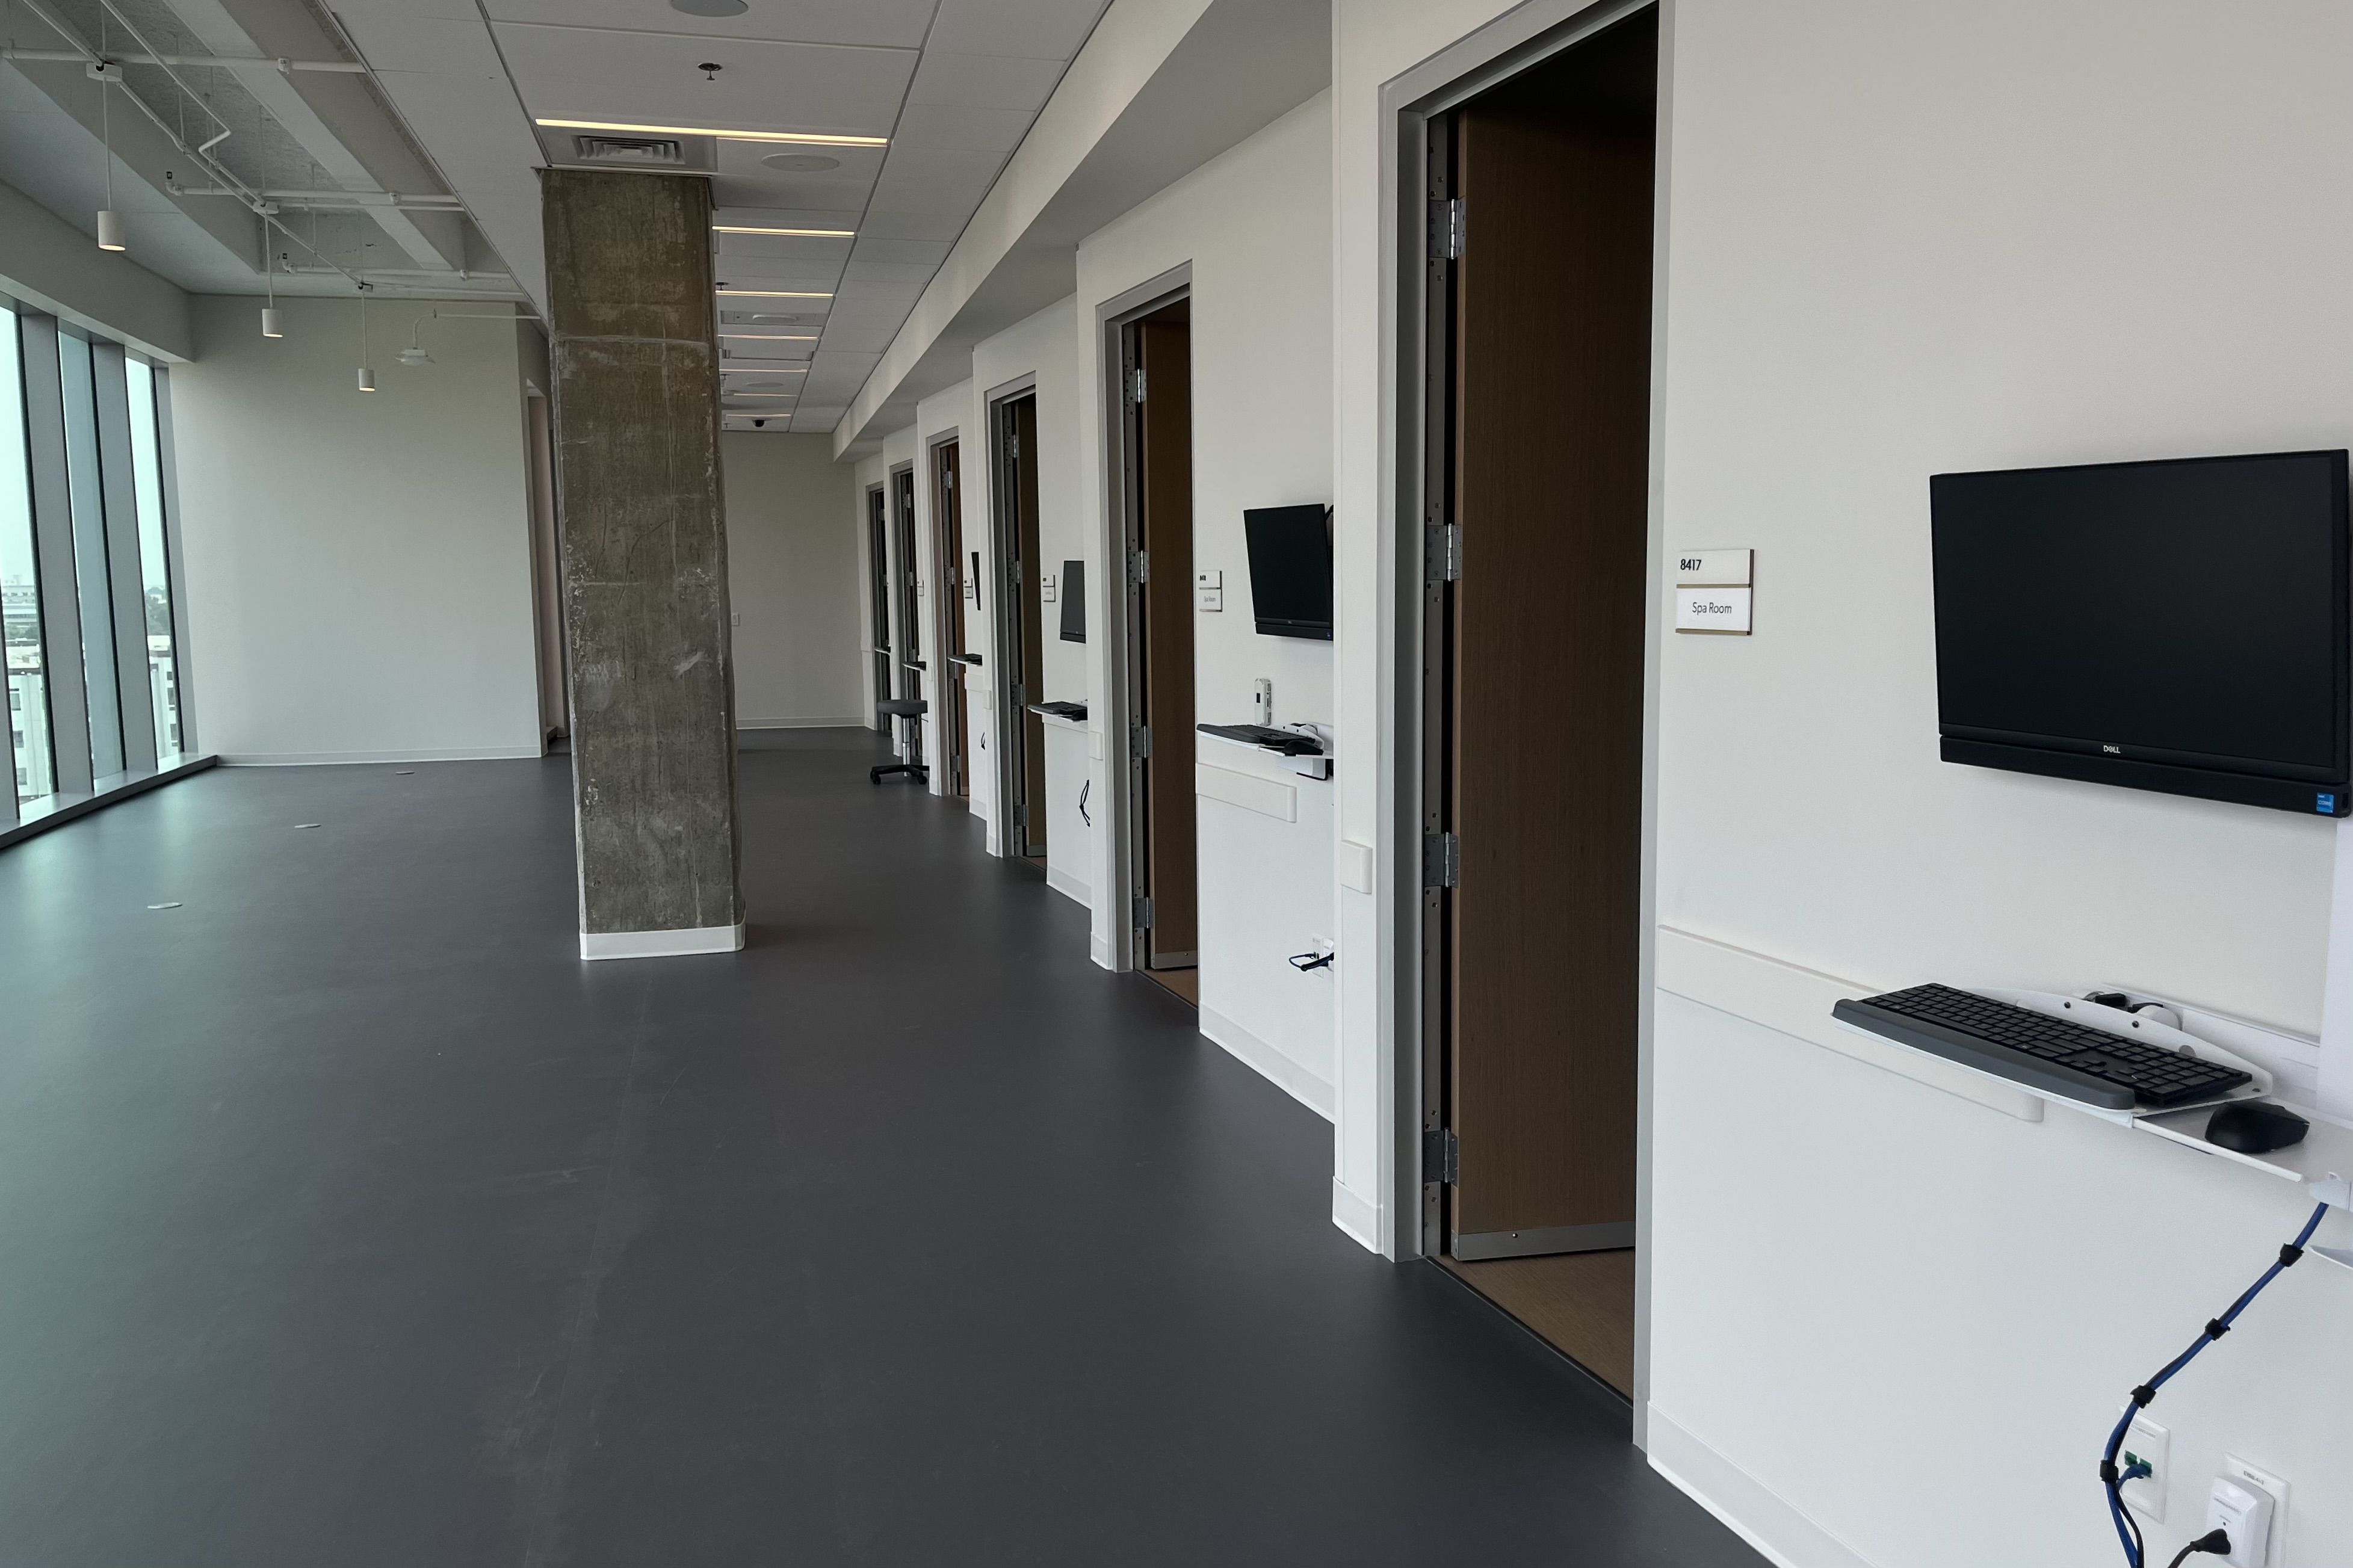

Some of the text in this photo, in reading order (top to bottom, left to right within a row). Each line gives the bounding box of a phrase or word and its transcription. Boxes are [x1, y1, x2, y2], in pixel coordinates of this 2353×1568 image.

[1680, 558, 1702, 571] 8417
[1692, 602, 1732, 615] Spa Room
[2103, 745, 2121, 754] DELL
